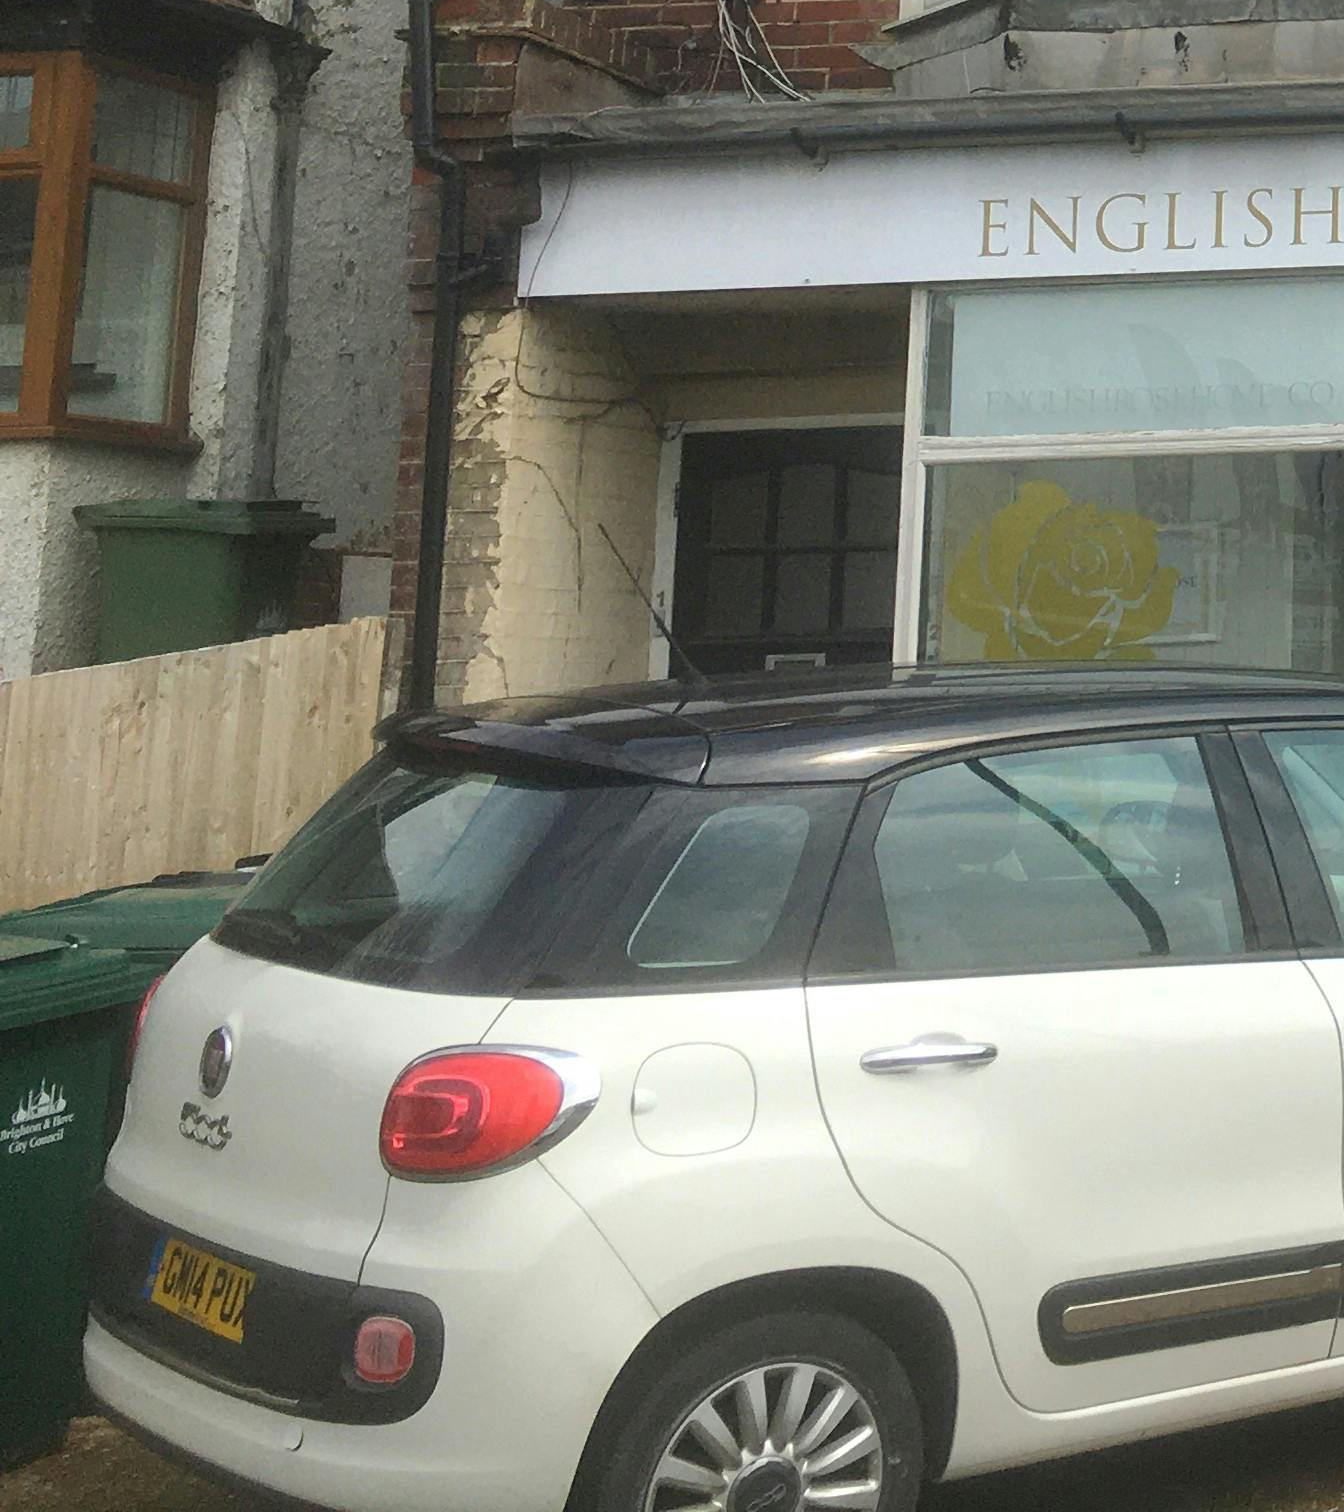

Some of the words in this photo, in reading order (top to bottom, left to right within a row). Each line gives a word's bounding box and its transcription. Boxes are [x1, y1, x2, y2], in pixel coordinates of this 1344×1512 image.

[978, 184, 1344, 258] ENGLISH
[0, 1121, 42, 1142] Brighton
[43, 1118, 51, 1130] &
[53, 1113, 74, 1128] Hove
[8, 1140, 28, 1154] City
[29, 1128, 65, 1148] Council
